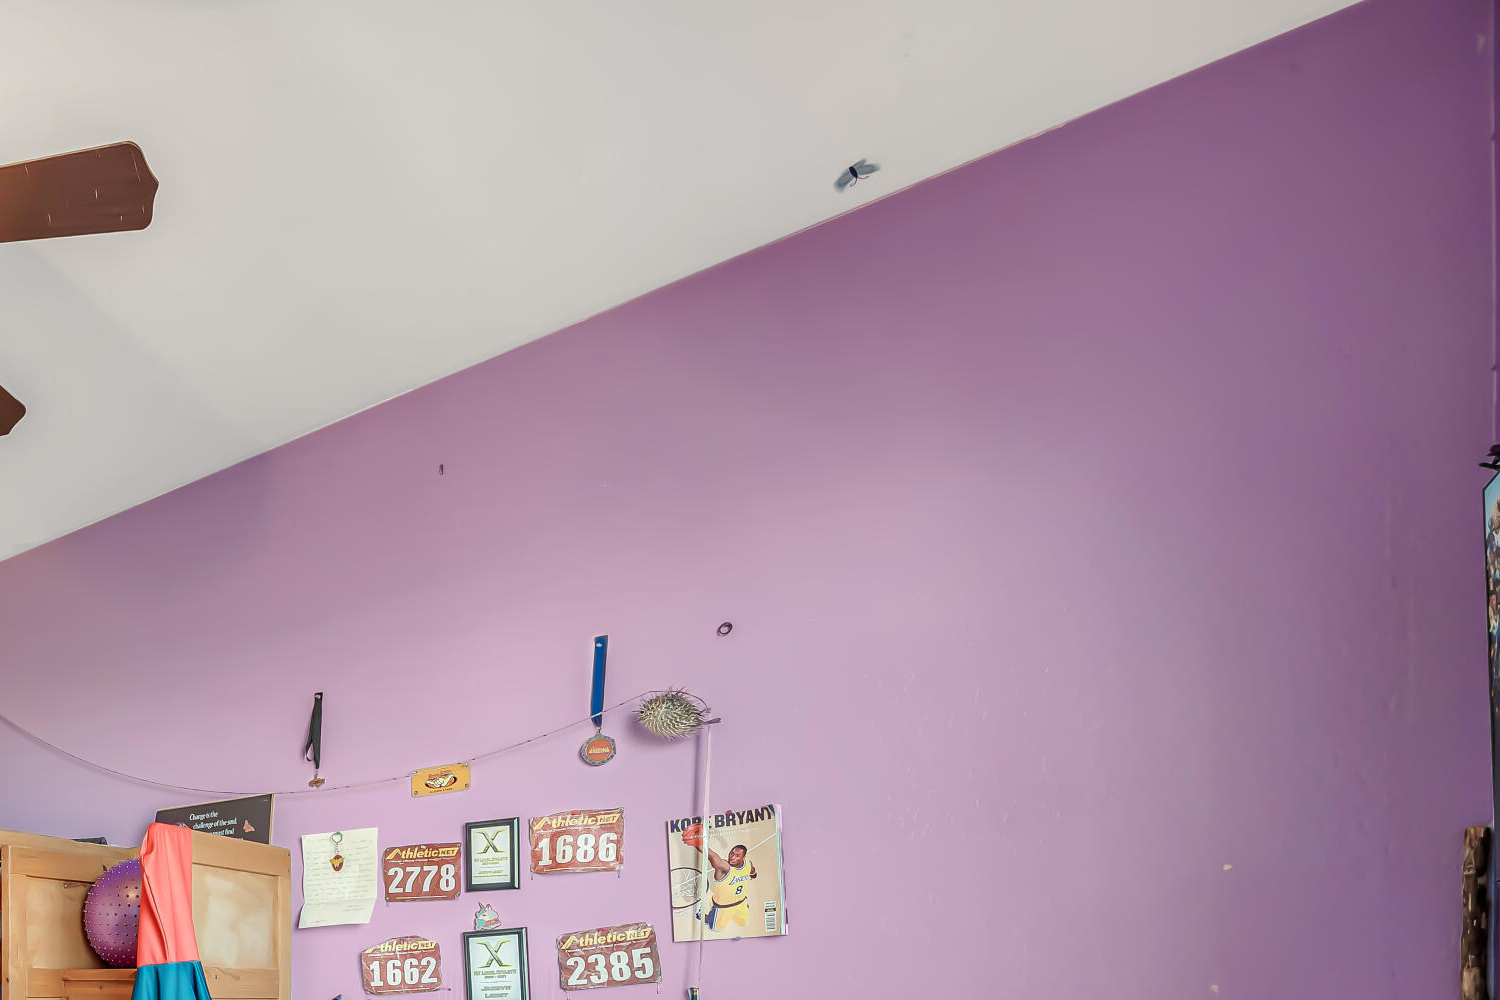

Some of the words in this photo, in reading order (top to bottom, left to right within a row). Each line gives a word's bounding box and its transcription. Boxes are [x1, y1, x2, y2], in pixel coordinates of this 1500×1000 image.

[535, 832, 618, 866] 1686
[387, 864, 456, 894] 2778
[369, 957, 437, 987] 1662
[567, 948, 654, 986] 2385
